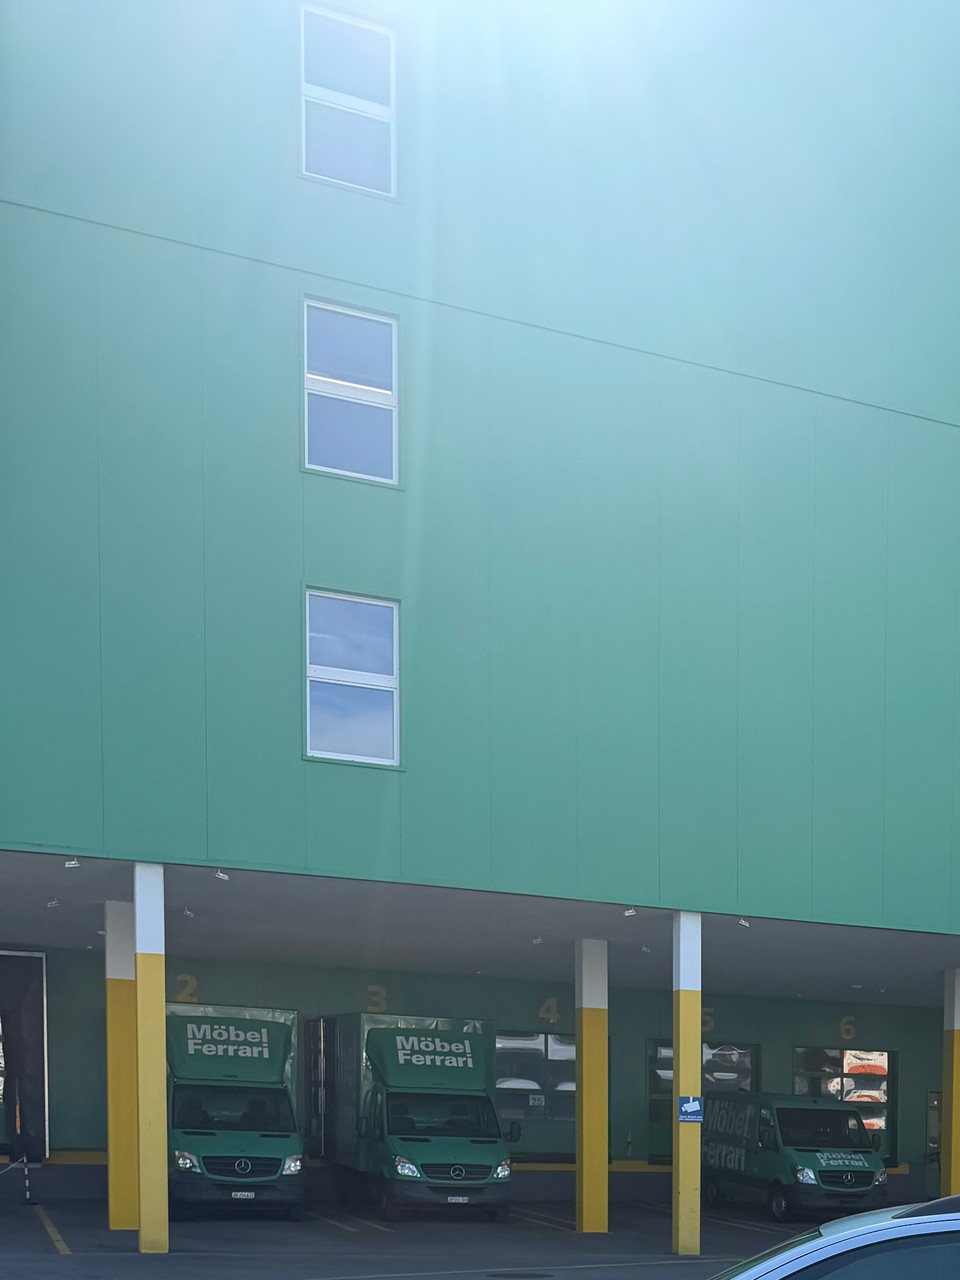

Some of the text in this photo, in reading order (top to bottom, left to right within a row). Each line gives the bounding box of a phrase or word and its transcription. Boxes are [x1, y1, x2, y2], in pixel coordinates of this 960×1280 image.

[176, 974, 199, 1003] 2
[367, 985, 387, 1012] 3
[538, 997, 560, 1024] 4
[701, 1007, 714, 1032] 5
[186, 1023, 269, 1043] Möbel
[839, 1015, 856, 1040] 6
[187, 1039, 270, 1059] Ferrari
[395, 1035, 472, 1053] Möbel
[397, 1050, 474, 1068] Ferrari
[704, 1099, 753, 1139] Möbel
[815, 1152, 865, 1161] Möbel
[820, 1158, 869, 1168] Ferrari
